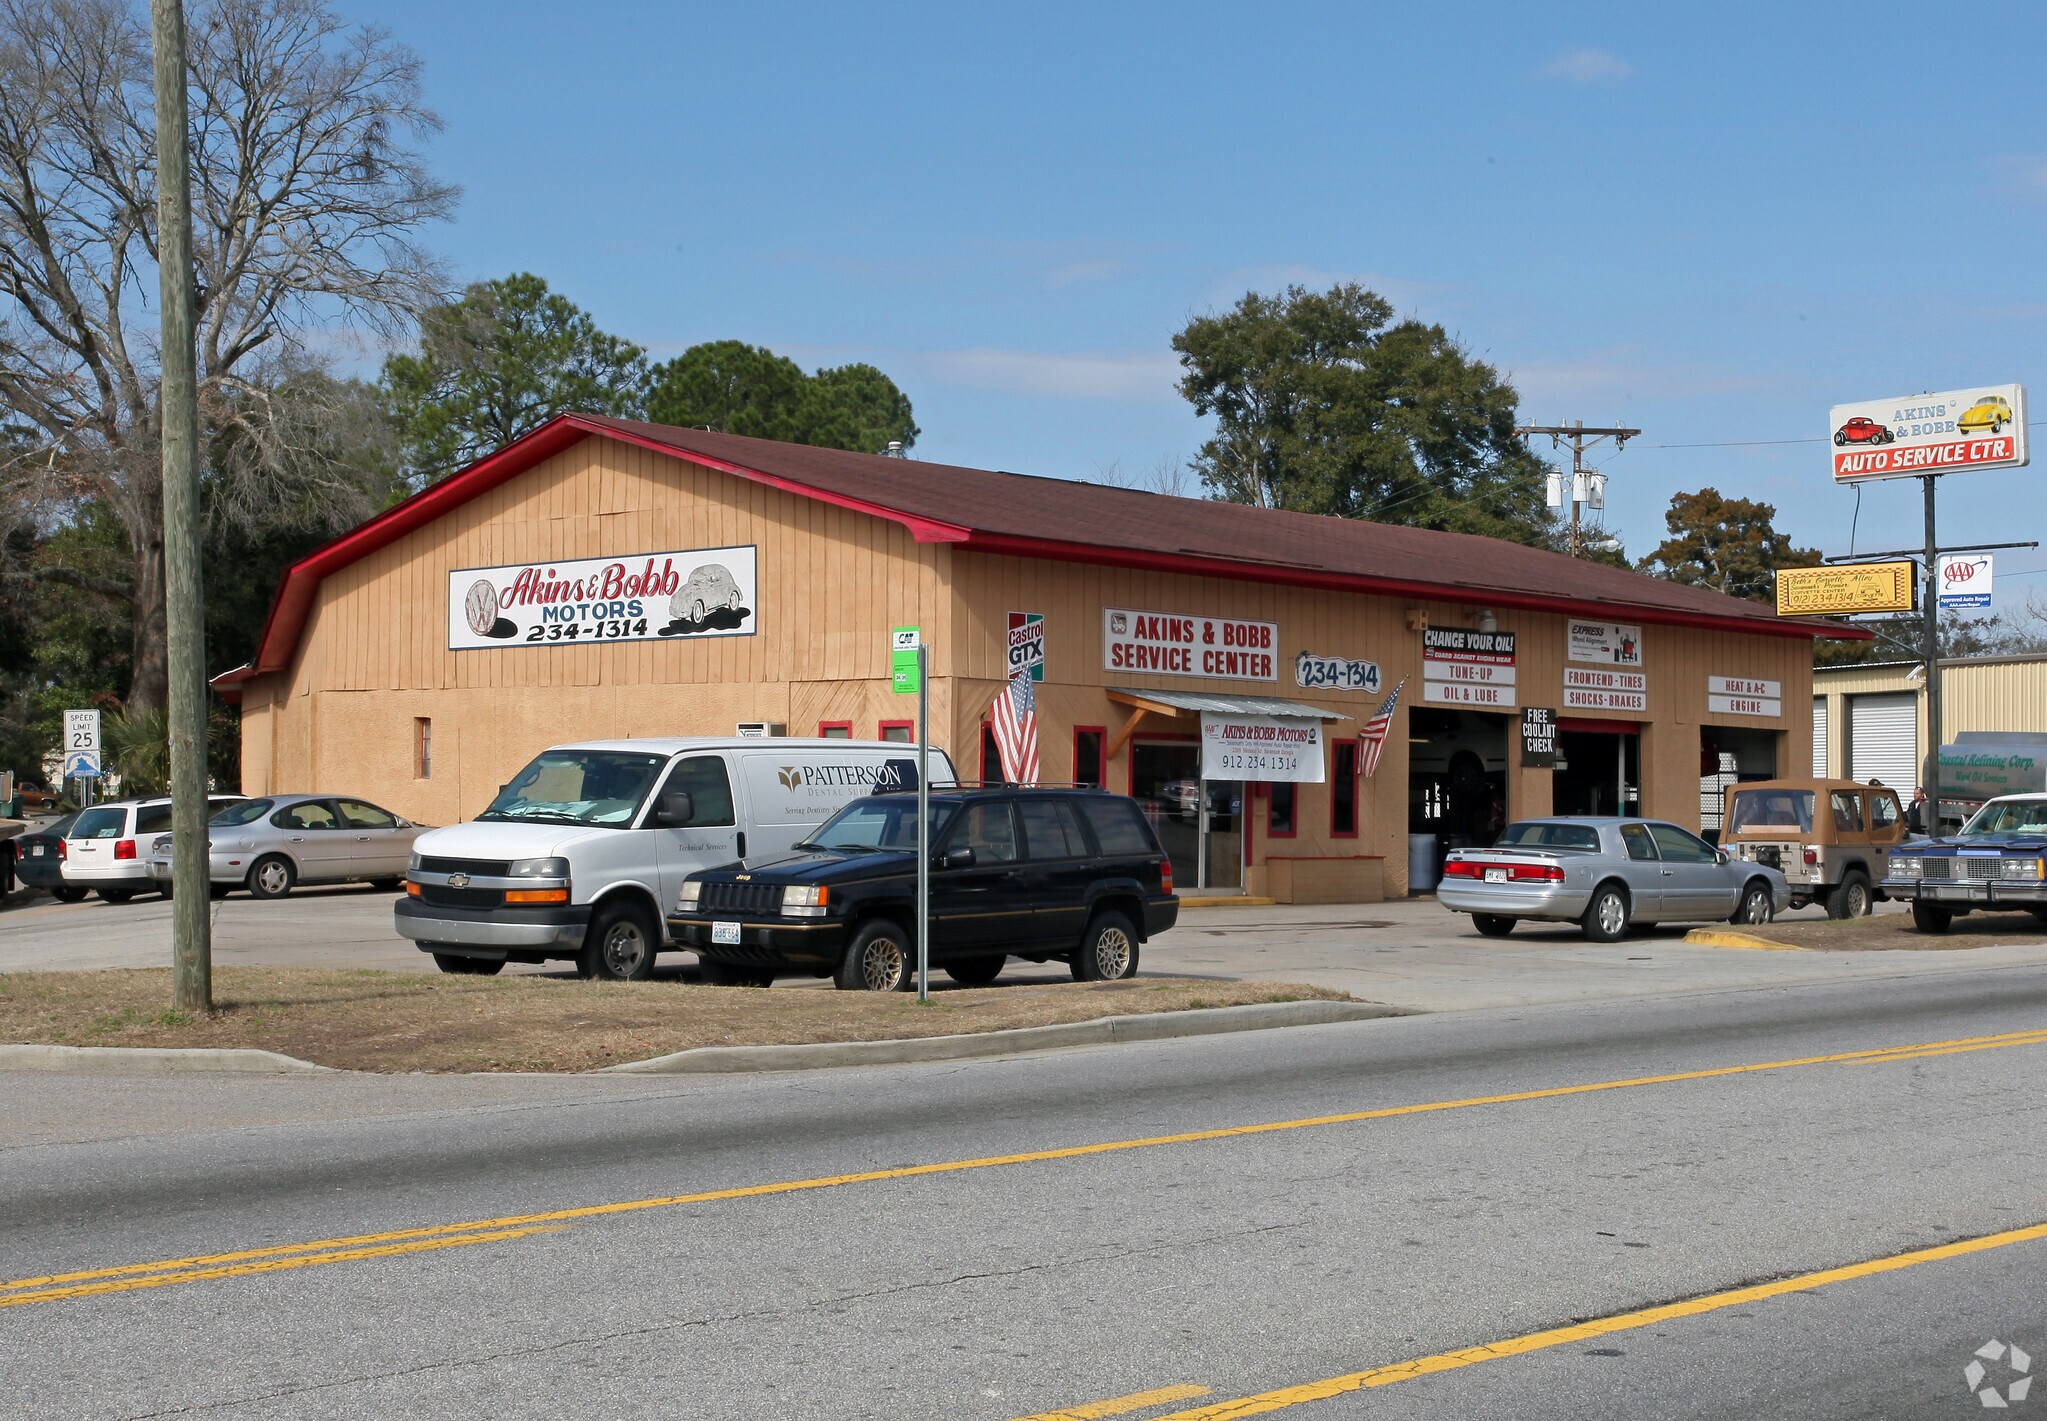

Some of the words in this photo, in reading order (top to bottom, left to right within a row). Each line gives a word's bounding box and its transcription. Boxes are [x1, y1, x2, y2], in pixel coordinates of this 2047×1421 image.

[1893, 404, 1946, 422] AKINS
[1896, 426, 1908, 438] &
[1911, 420, 1955, 438] BOBB
[1839, 452, 1887, 473] AUTO
[1891, 443, 1964, 468] SERVICE
[1969, 439, 2010, 460] CTR.
[1946, 562, 1972, 581] AAA
[500, 567, 583, 609] Akins
[586, 575, 598, 599] &
[599, 558, 680, 601] Bobb
[1790, 594, 1810, 604] (912)
[542, 599, 644, 624] MOTORS
[526, 618, 648, 641] 234-1314
[1009, 621, 1043, 646] Castrol
[1134, 616, 1195, 643] AKINS
[1202, 621, 1215, 645] &
[1223, 623, 1272, 649] BOBB
[1572, 625, 1604, 636] EXPRESS
[899, 633, 914, 644] CAT
[1424, 630, 1465, 648] CHANGE
[1467, 634, 1493, 650] YOUR
[1495, 636, 1514, 652] OIL!
[1586, 637, 1607, 645] Alignment
[1009, 638, 1042, 665] GTX
[1453, 653, 1476, 661] AGAINST
[1111, 643, 1192, 672] SERVICE
[1203, 650, 1272, 677] CENTER
[1302, 661, 1378, 687] 234-1314
[1449, 665, 1493, 680] TUNE-UP
[1444, 686, 1459, 700] OIL
[1463, 688, 1469, 700] &
[1475, 689, 1498, 702] LUBE
[1726, 680, 1744, 692] HEAT
[1746, 682, 1751, 693] &
[1754, 683, 1765, 694] A-C
[1731, 700, 1761, 712] ENGINE
[1527, 708, 1548, 723] FREE
[1222, 725, 1245, 739] AKINS
[1246, 726, 1253, 740] &
[1253, 726, 1276, 740] BOBB
[1276, 727, 1308, 742] MOTORS
[1523, 723, 1556, 738] COOLANT
[73, 733, 92, 747] 25
[1527, 738, 1553, 752] CHECK
[1223, 755, 1297, 770] 912.234.1314
[1968, 753, 2007, 770] Refining
[2009, 754, 2034, 771] Corp.
[802, 765, 902, 785] PATTERSON
[808, 788, 843, 797] DENTAL
[806, 806, 830, 814] Dentistry
[679, 844, 704, 852] Technical
[706, 843, 727, 851] Services
